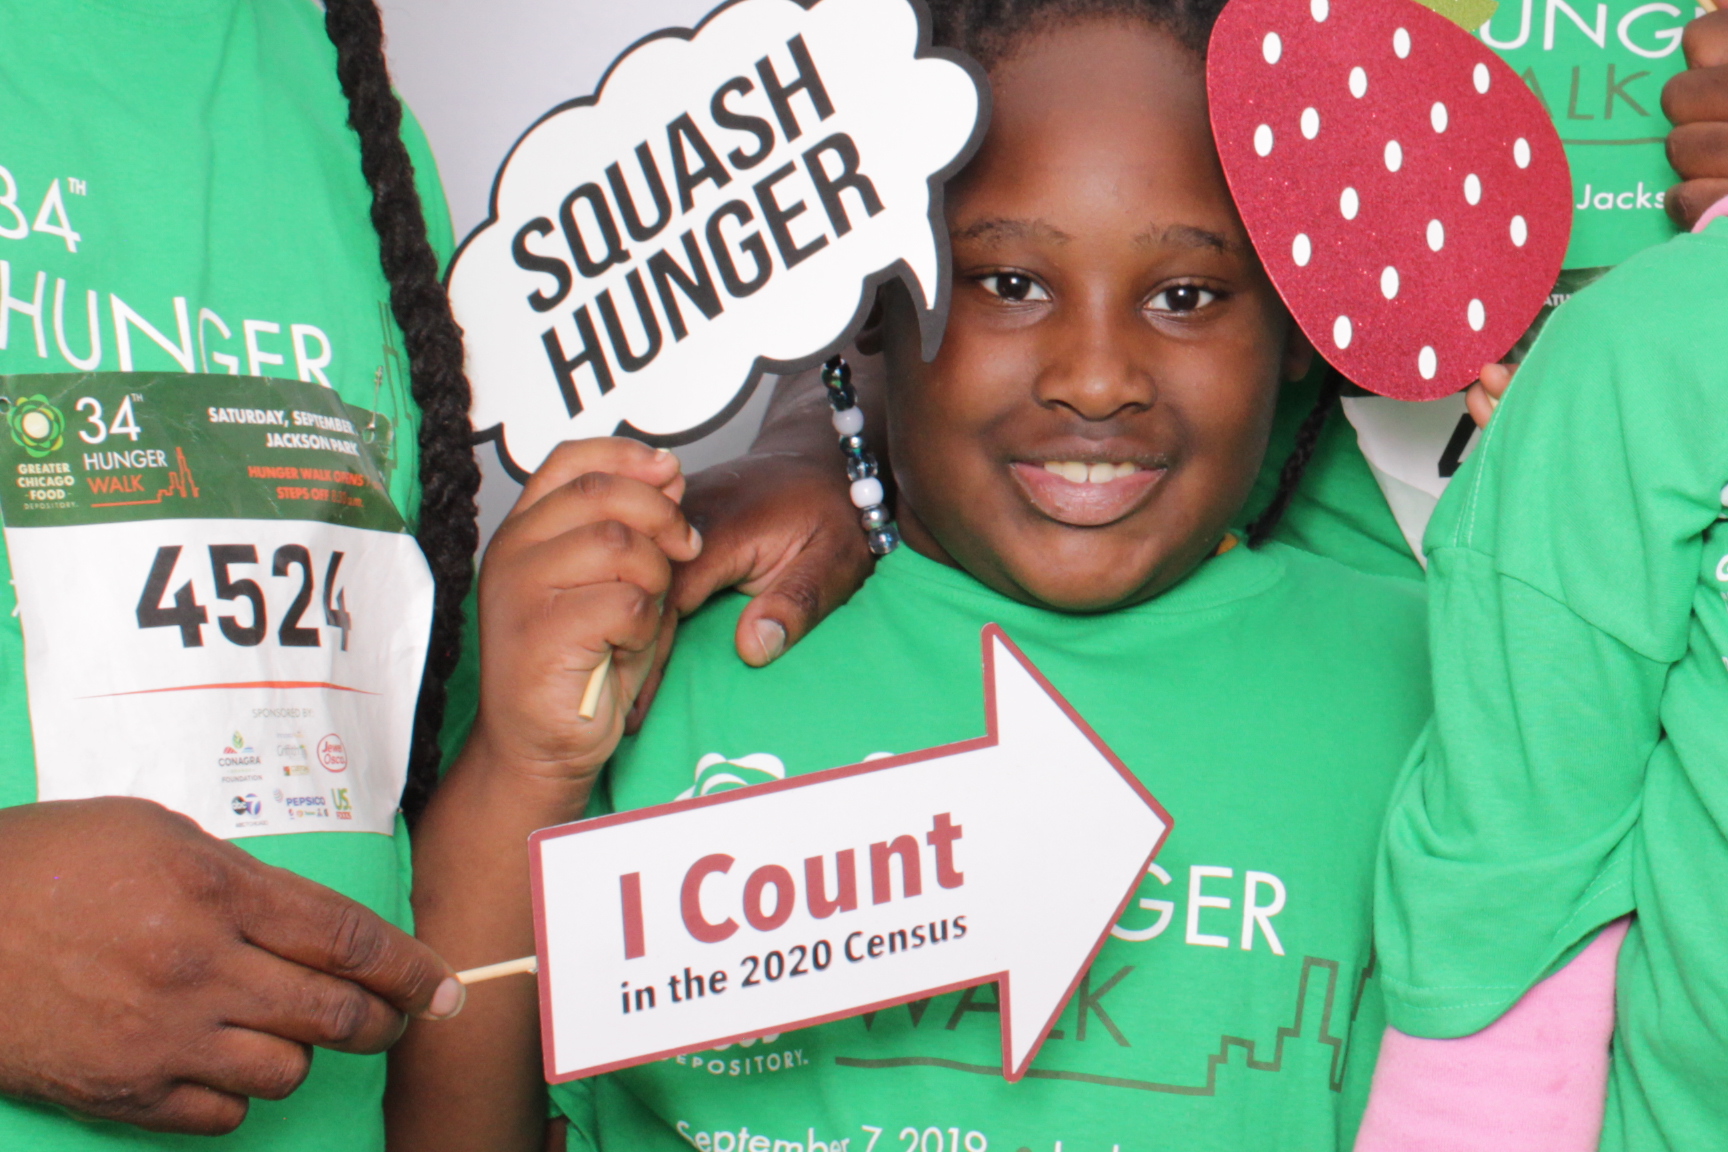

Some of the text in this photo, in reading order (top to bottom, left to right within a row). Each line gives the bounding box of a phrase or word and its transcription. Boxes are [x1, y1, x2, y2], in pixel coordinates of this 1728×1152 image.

[511, 32, 836, 313] SQUASH
[1576, 182, 1666, 210] Jacks
[540, 132, 886, 420] HUNGER
[0, 260, 332, 388] HUNGER
[207, 406, 289, 428] SATURDAY,
[265, 432, 361, 457] JACKSON PARK
[17, 462, 71, 475] GREATER
[83, 449, 168, 471] HUNGER
[247, 465, 300, 480] HUNGER
[17, 475, 75, 488] CHICAGO
[86, 474, 145, 494] WALK
[29, 489, 66, 501] FOOD
[136, 544, 352, 652] 4524
[218, 755, 262, 767] CONAGRA
[286, 796, 326, 807] PEPSICO
[619, 811, 965, 961] I Count
[1108, 860, 1286, 956] GER
[621, 914, 968, 1014] in the 2020 Census
[660, 1049, 803, 1076] EPOSITORY
